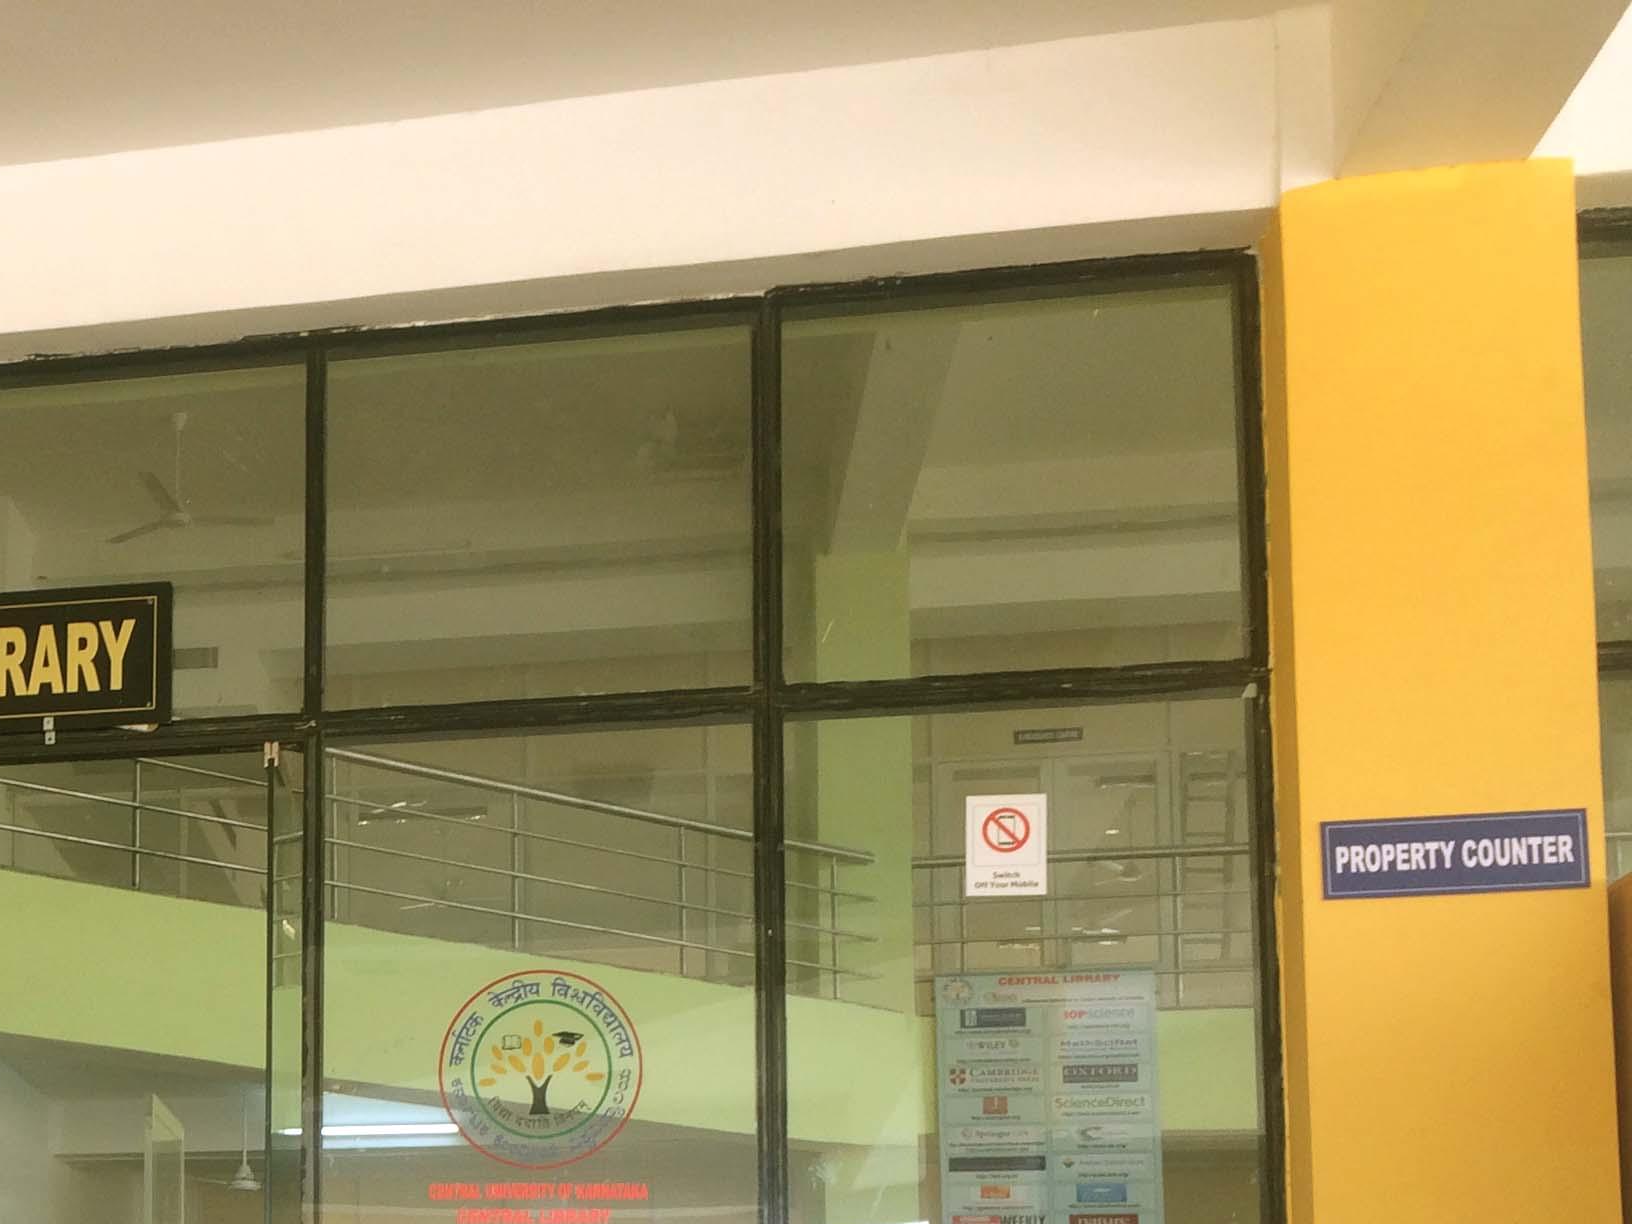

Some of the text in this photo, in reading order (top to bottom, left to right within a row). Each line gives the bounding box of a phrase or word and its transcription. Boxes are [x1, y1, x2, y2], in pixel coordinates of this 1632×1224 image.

[1335, 834, 1575, 874] PROPERTY COUNTER
[992, 871, 1020, 880] Switch
[974, 881, 988, 889] Off
[1010, 880, 1039, 888] Mobile
[997, 973, 1121, 986] CENTRAL LIBRARY
[539, 1207, 612, 1224] LIBRARY
